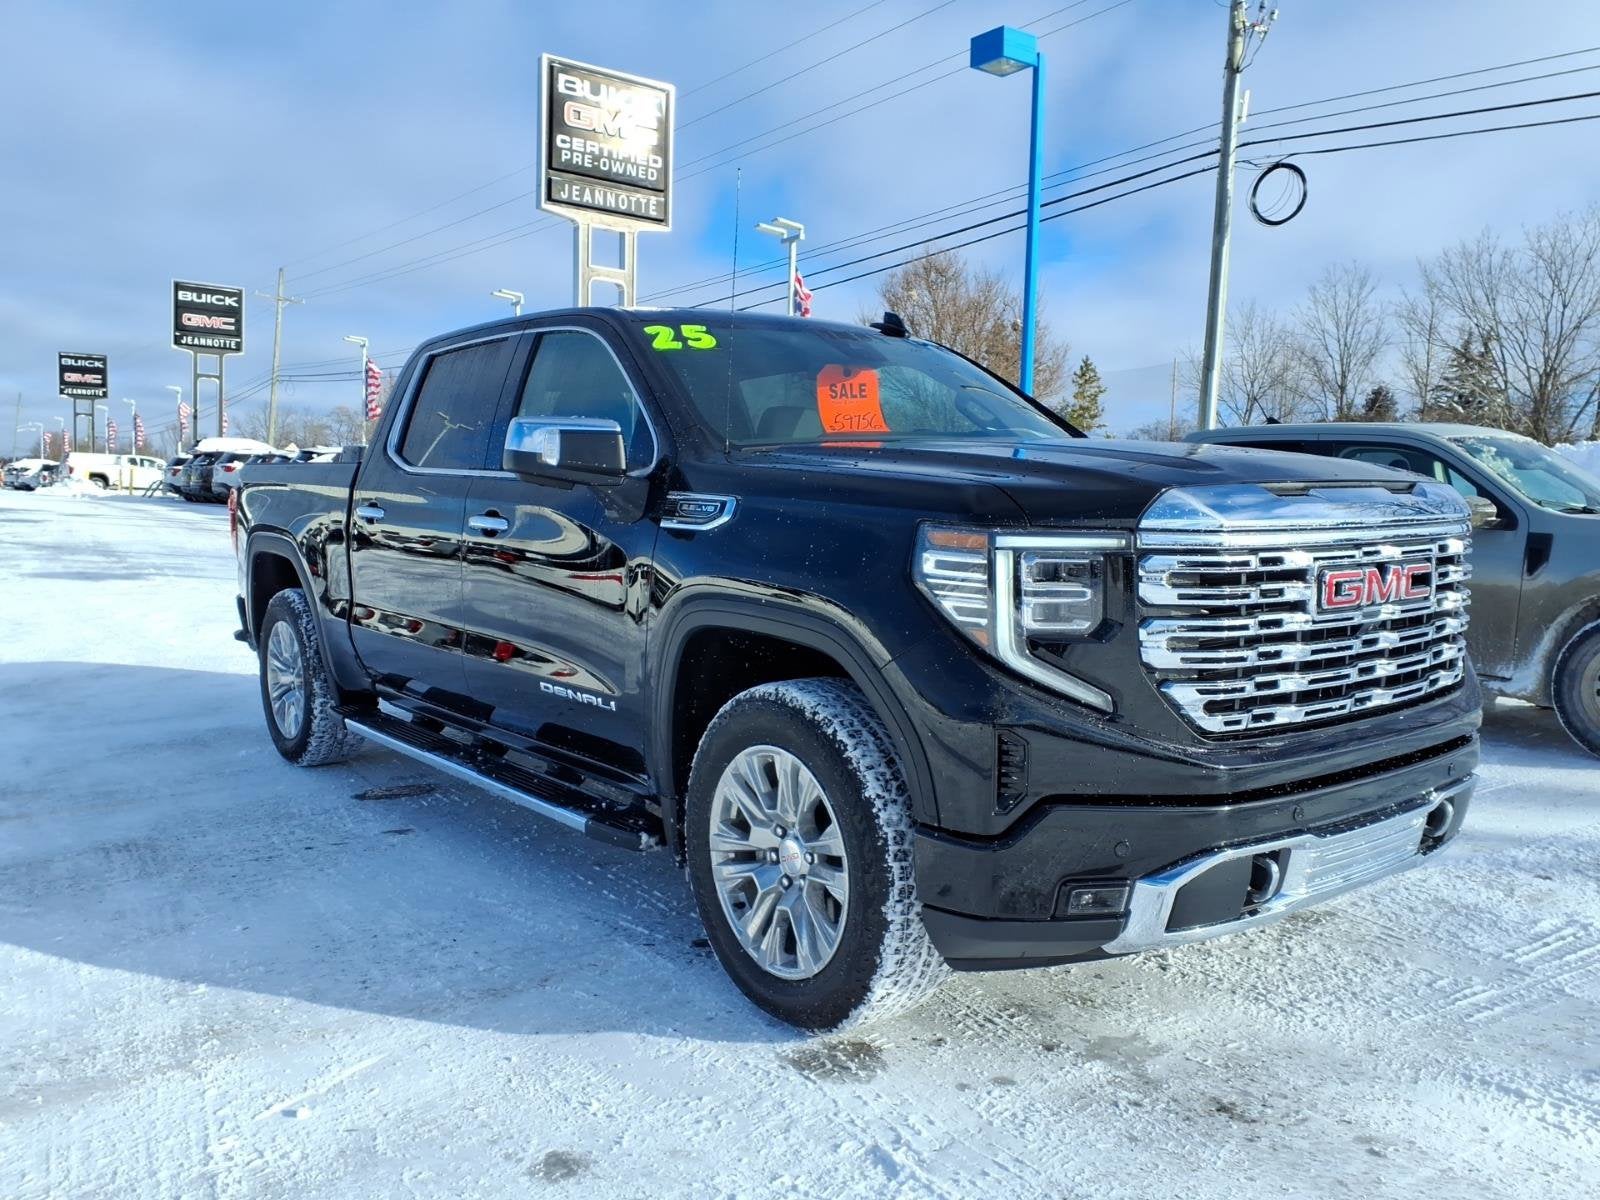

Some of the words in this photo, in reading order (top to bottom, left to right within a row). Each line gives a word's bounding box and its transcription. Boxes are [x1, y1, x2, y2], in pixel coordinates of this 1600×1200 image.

[558, 73, 662, 119] BUI
[556, 134, 662, 168] CERTIFIED
[562, 150, 657, 180] PRE-OWNED
[561, 184, 657, 215] JEANNOTTE
[178, 291, 239, 306] BUICK
[182, 313, 236, 330] GMC
[181, 336, 237, 349] JEANNOTTE
[643, 325, 717, 351] 25
[61, 358, 104, 368] BUICK
[63, 388, 103, 396] JEANNOTTE
[829, 383, 867, 399] SALE
[1322, 563, 1432, 609] GMC
[540, 682, 616, 711] DENALI
